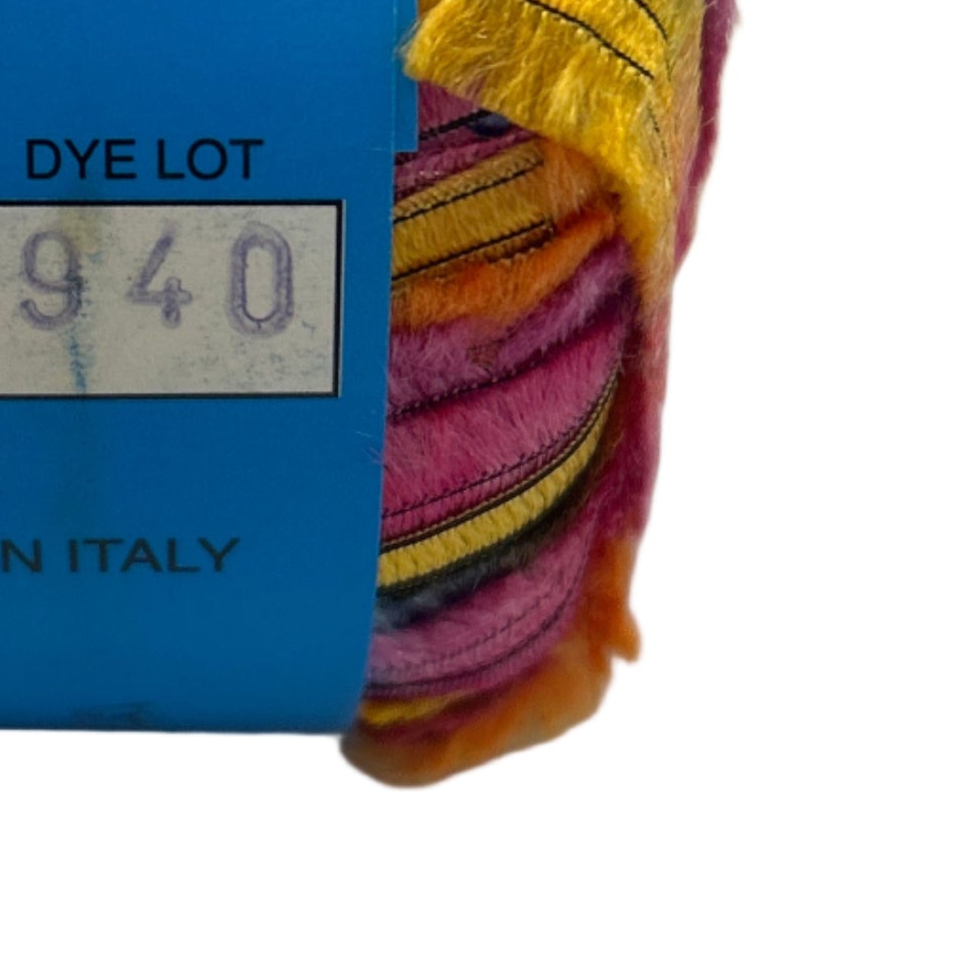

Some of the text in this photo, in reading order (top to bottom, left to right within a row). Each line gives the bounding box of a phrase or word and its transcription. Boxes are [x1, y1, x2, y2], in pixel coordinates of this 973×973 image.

[27, 138, 265, 179] DYE LOT
[68, 537, 241, 574] ITALY
